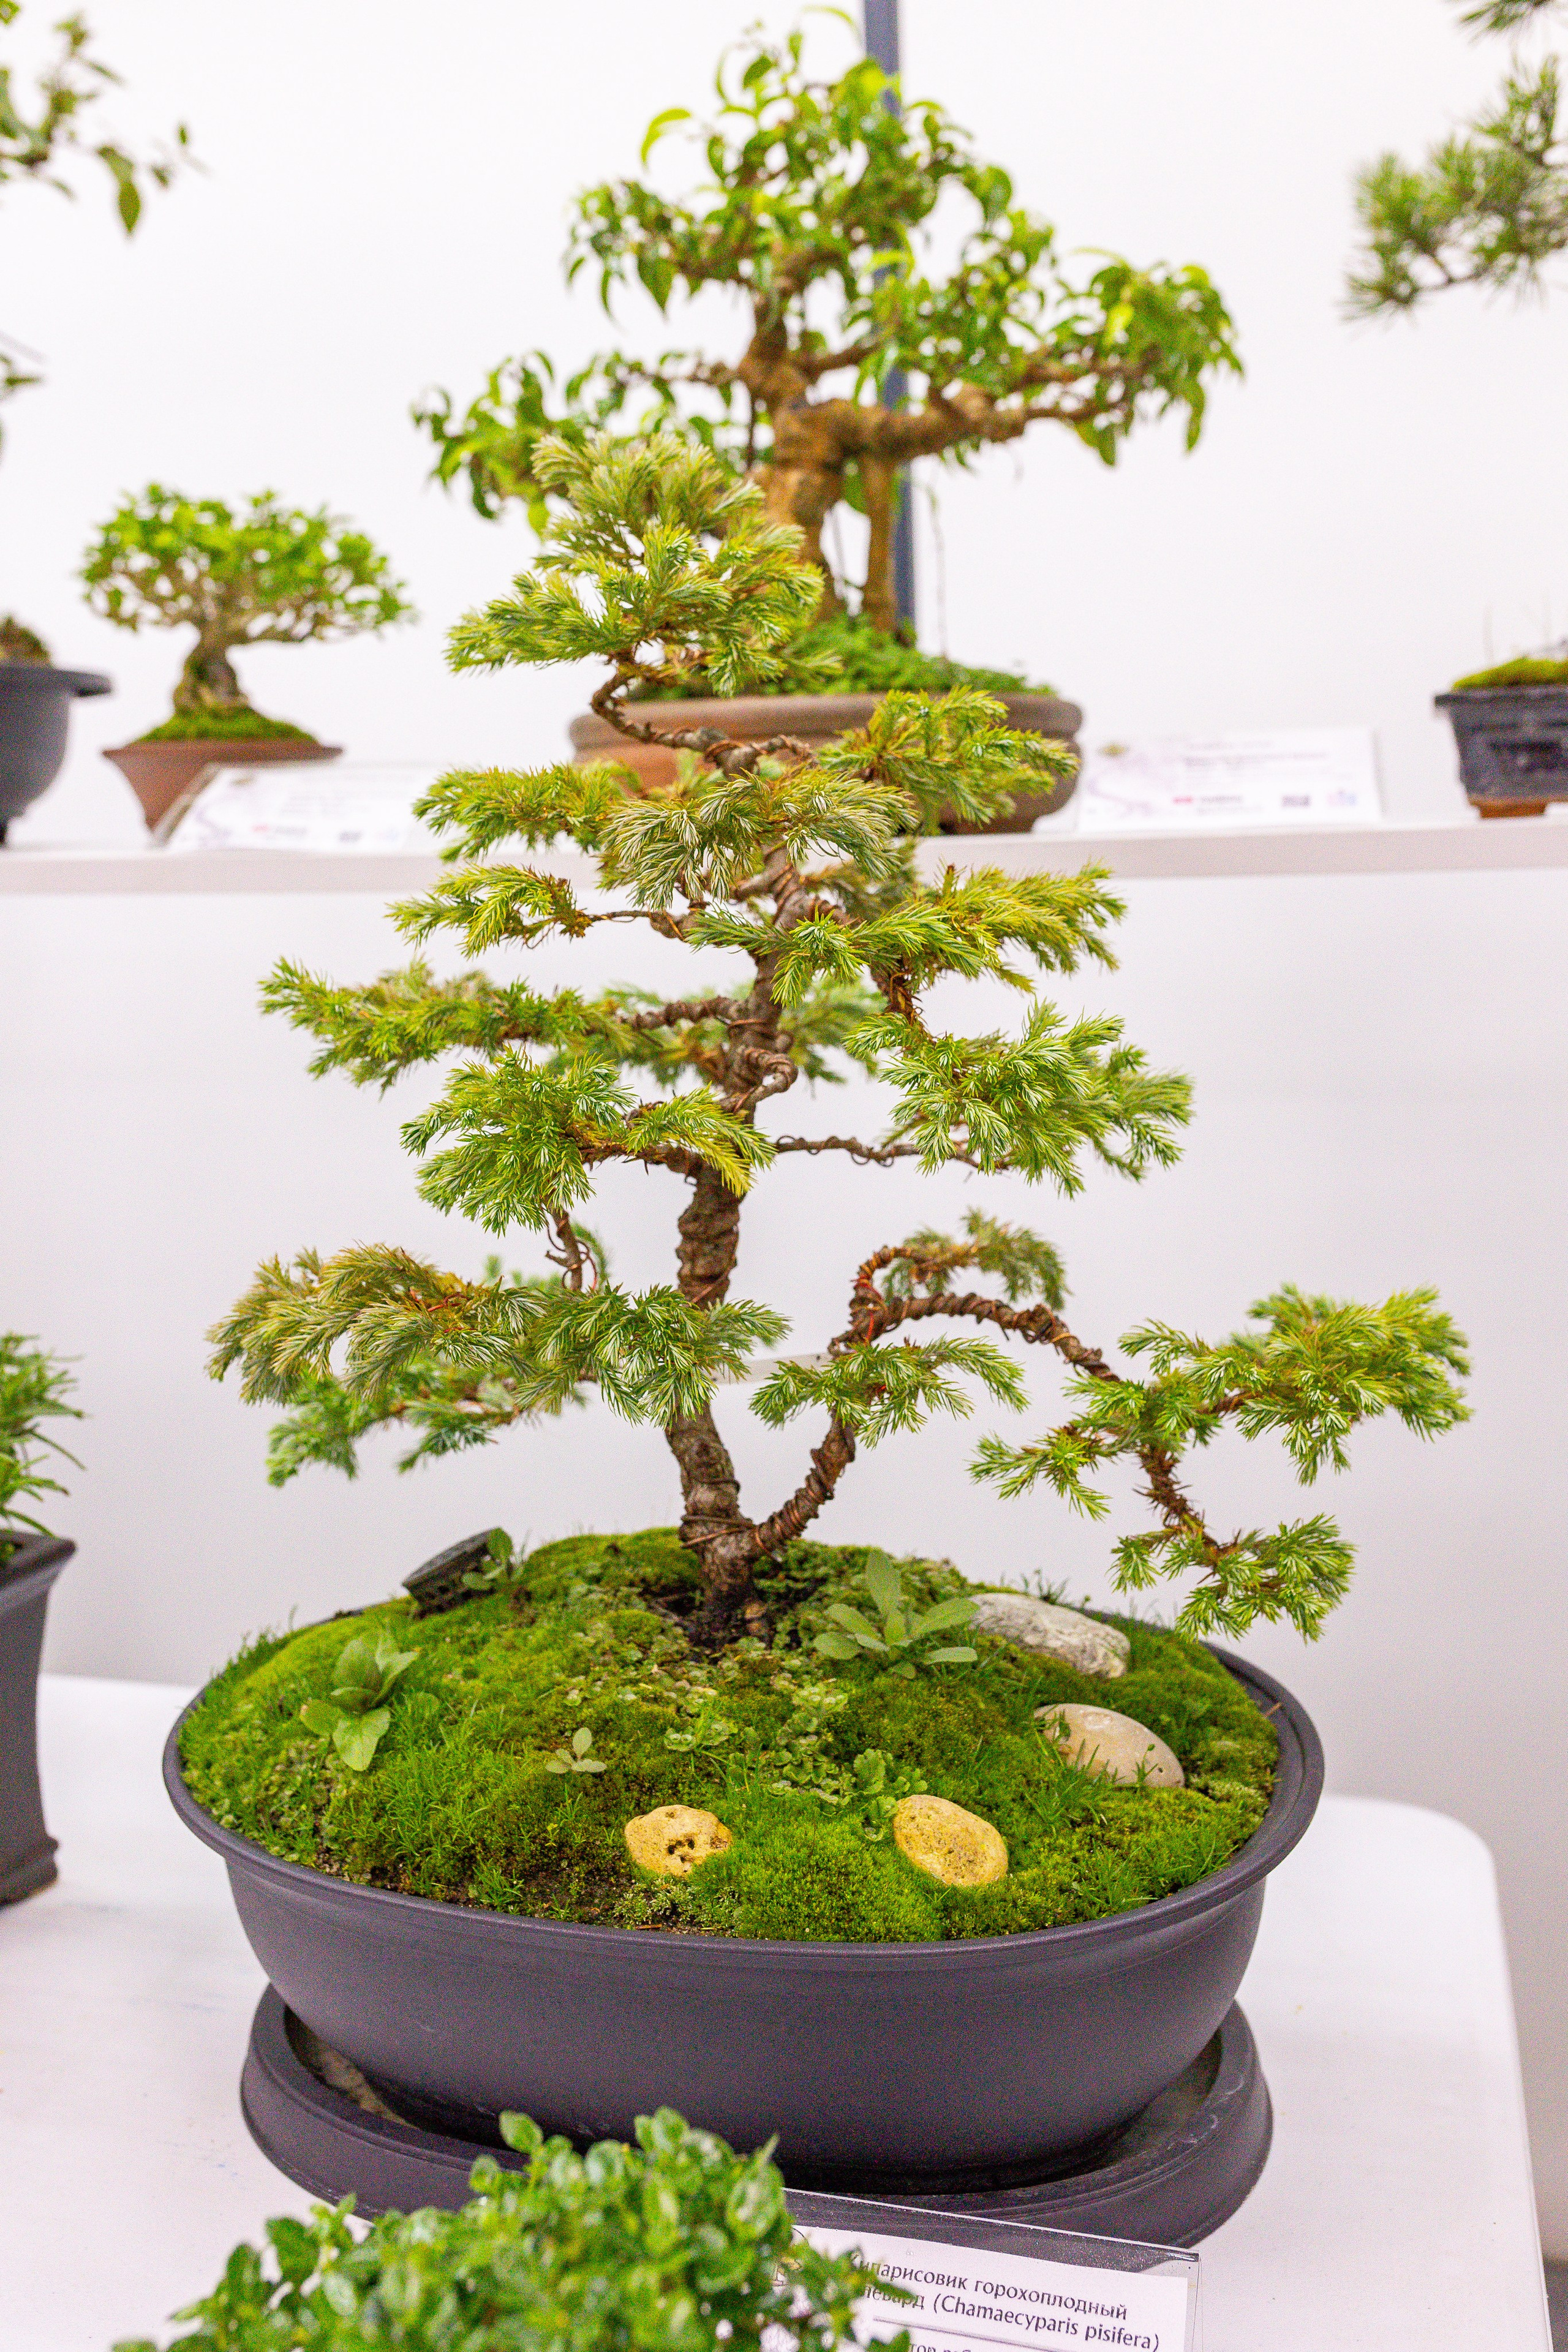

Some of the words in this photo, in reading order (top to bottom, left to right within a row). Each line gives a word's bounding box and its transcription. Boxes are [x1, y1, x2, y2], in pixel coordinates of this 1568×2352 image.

[933, 2293, 1079, 2335] (Chamaecyparis
[1085, 2324, 1159, 2352] pisifera)
[974, 2280, 1127, 2320] горохоплодный
